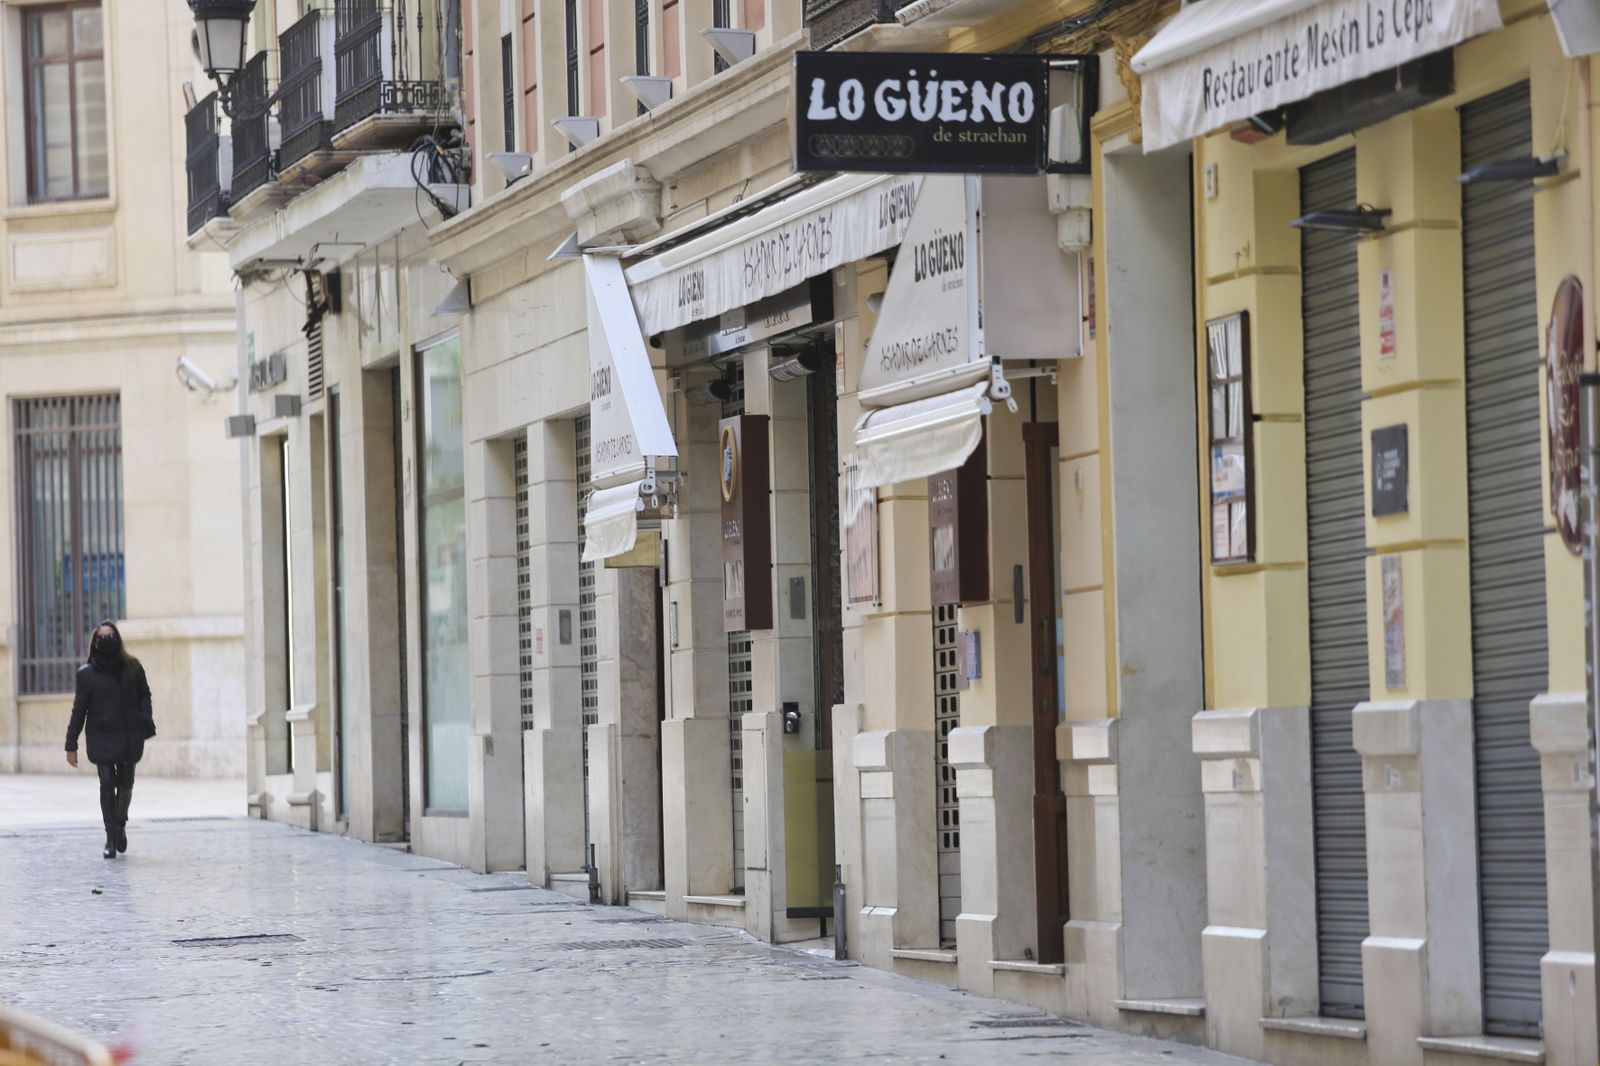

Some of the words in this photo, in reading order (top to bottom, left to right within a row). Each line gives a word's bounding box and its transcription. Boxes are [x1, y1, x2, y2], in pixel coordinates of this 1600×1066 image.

[1202, 39, 1298, 112] Restaurante
[1366, 1, 1385, 49] La
[1392, 0, 1433, 43] Cepa
[807, 77, 865, 121] LO
[874, 69, 1034, 124] GÜENO
[933, 126, 952, 143] de
[958, 127, 1027, 143] strachan
[879, 192, 889, 229] LO
[914, 243, 927, 283] LO
[928, 229, 964, 278] GÜENO
